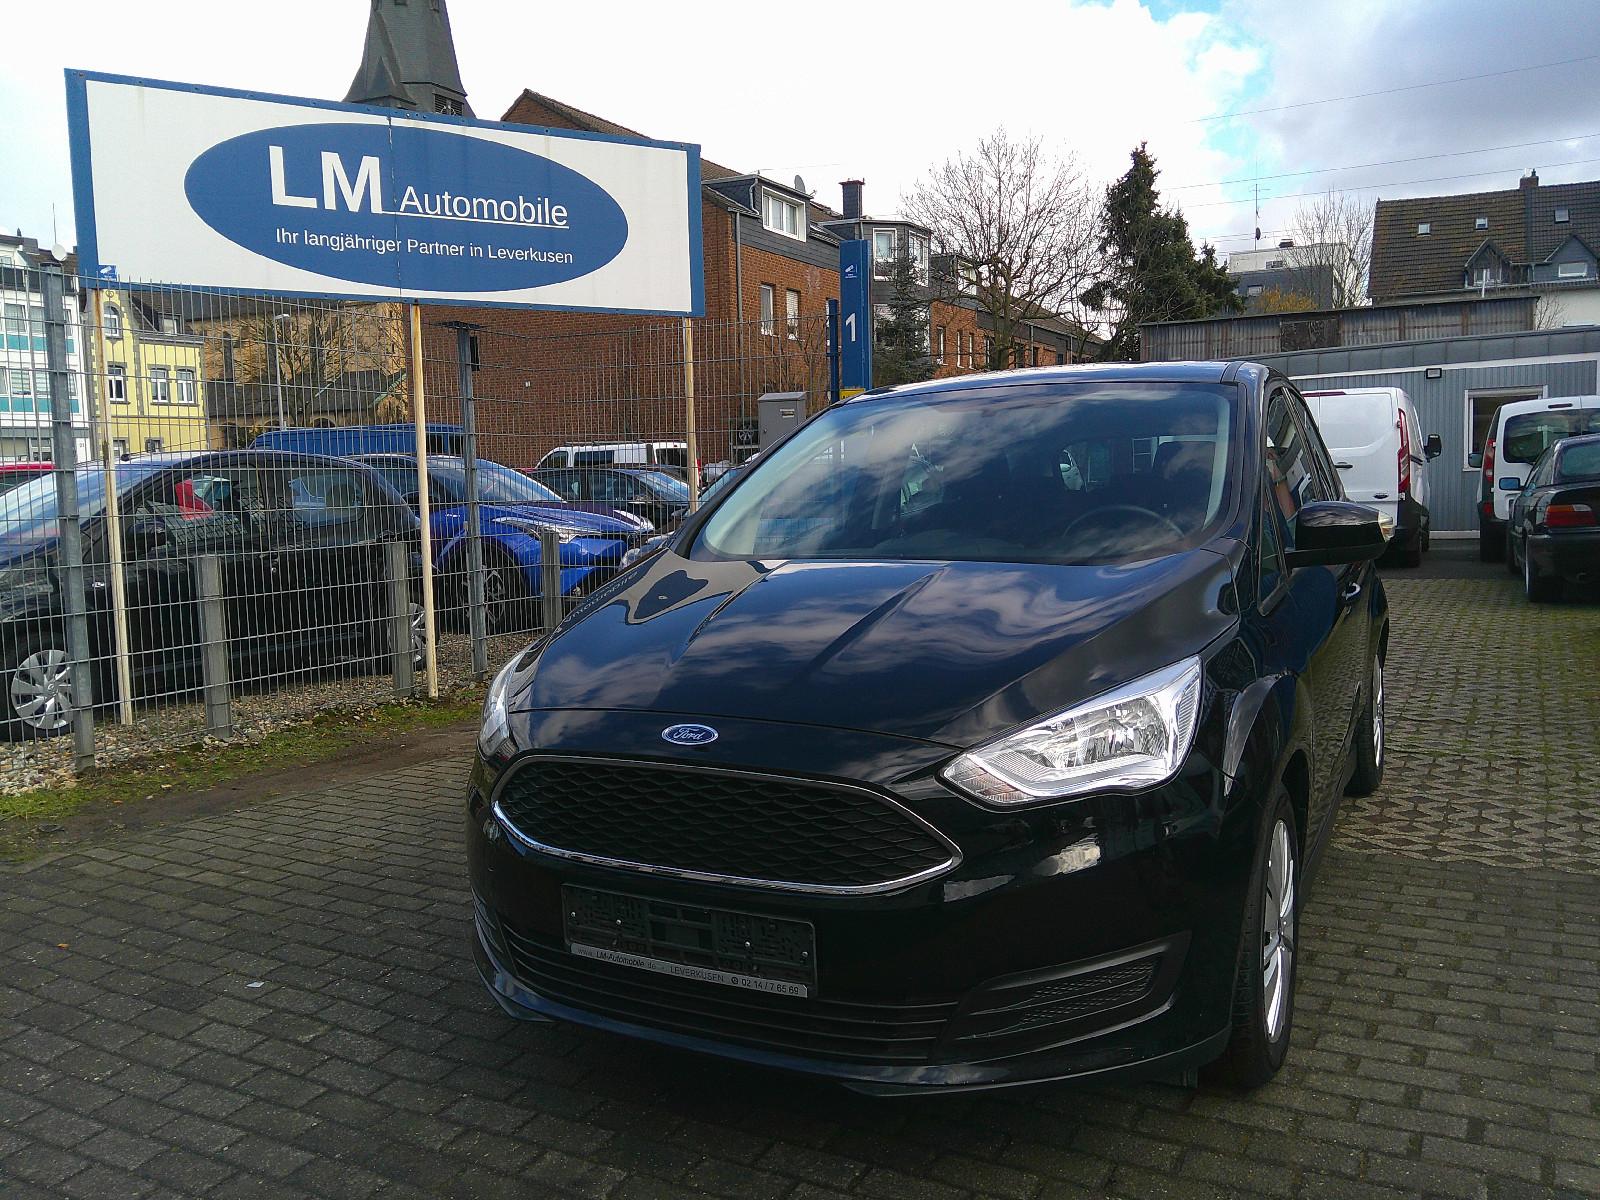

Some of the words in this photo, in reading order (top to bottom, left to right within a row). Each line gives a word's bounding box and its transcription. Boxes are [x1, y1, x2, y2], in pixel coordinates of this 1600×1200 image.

[268, 145, 383, 214] LM
[399, 185, 568, 226] Automobile
[276, 227, 299, 243] Ihr
[303, 229, 402, 254] langjähriger
[407, 238, 464, 257] Partner
[469, 242, 483, 258] in
[488, 244, 573, 264] Leverkusen
[845, 312, 856, 342] 1
[673, 727, 706, 740] Ford
[670, 966, 724, 982] LEVERKUSEN
